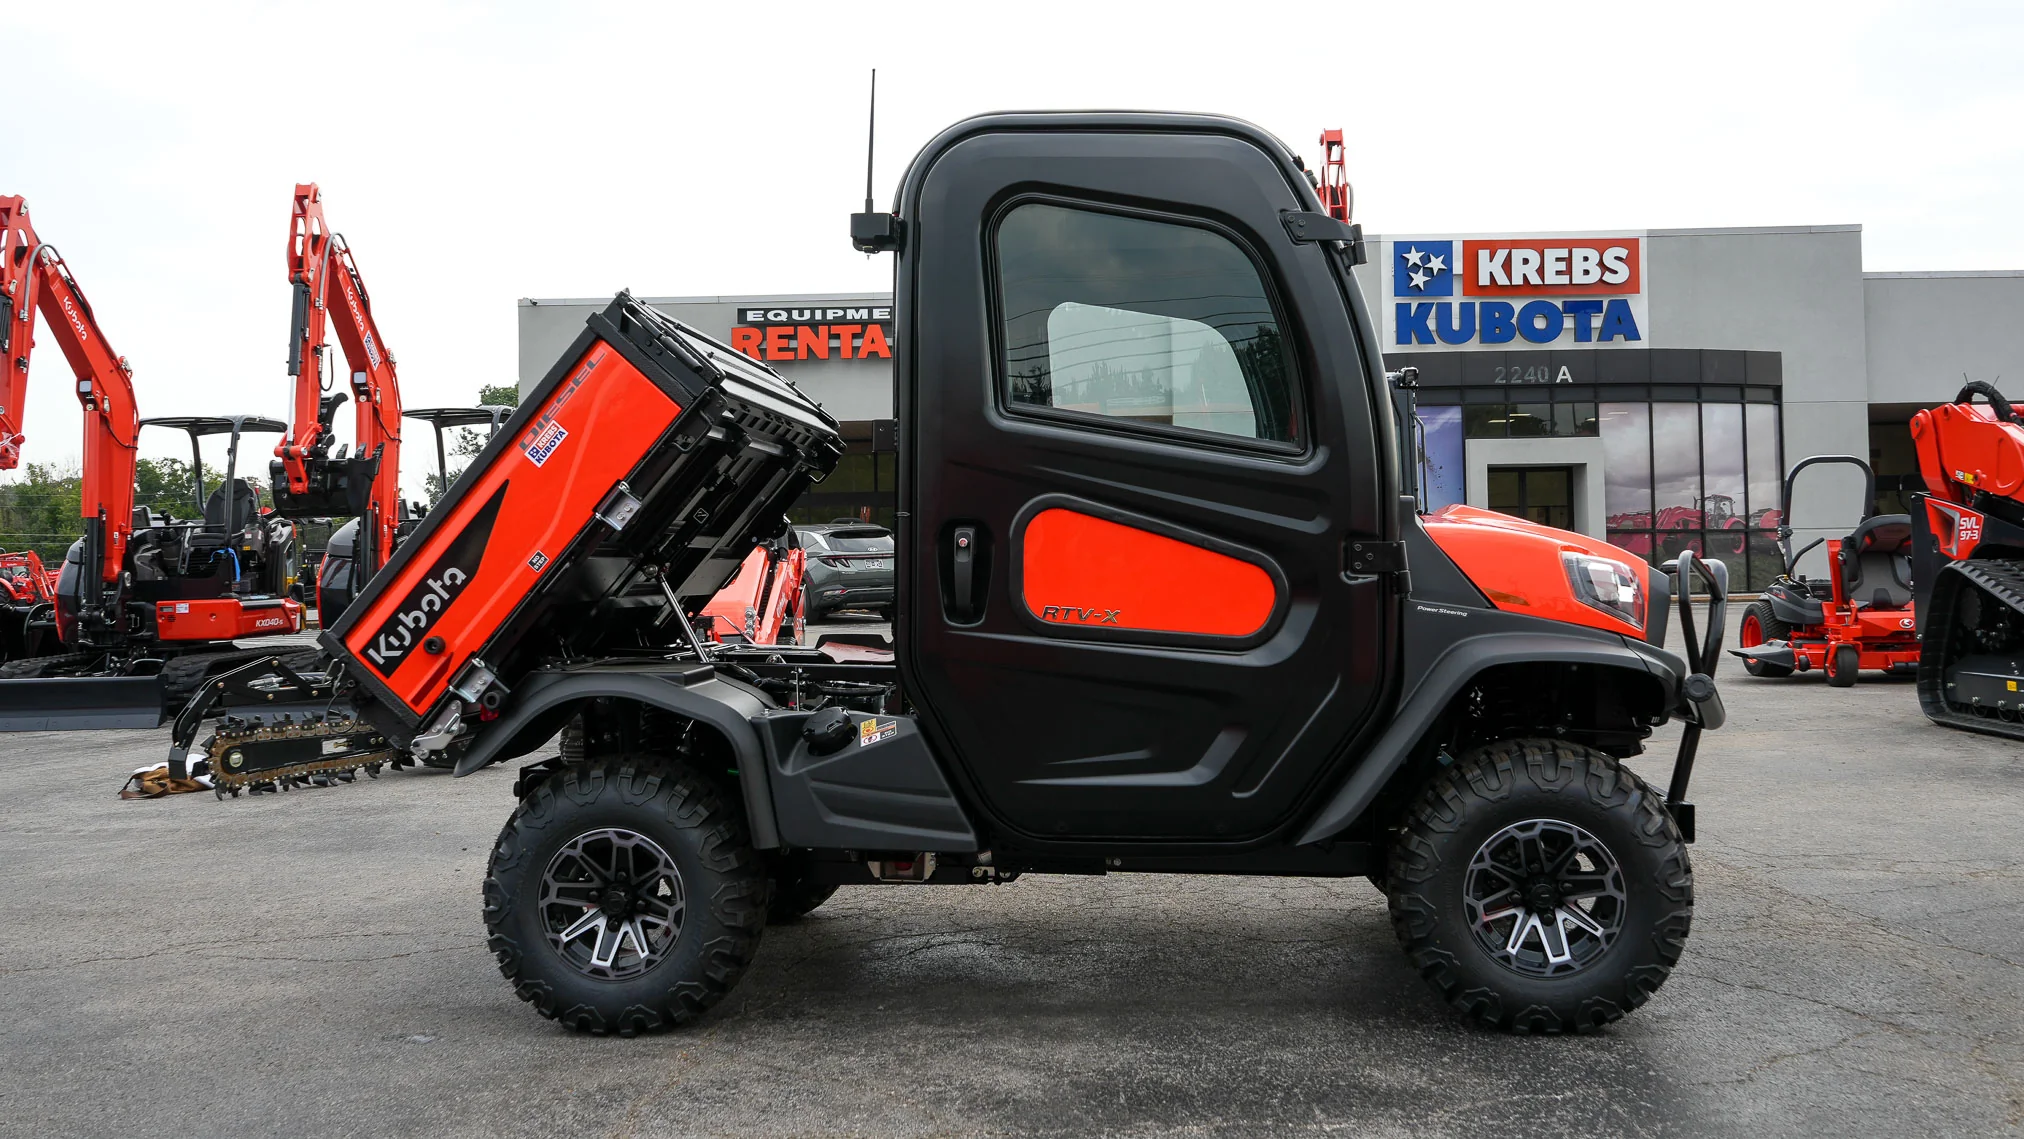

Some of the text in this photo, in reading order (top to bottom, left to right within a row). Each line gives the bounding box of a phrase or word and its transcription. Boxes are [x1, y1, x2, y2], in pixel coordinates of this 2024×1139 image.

[1478, 246, 1630, 287] KREBS
[63, 296, 88, 341] Kubota
[347, 286, 365, 331] Kubota
[1395, 299, 1641, 345] KUBOTA
[1494, 365, 1573, 384] 2240 A
[518, 352, 606, 451] DIESEL
[535, 430, 566, 464] KUBOTA
[538, 425, 557, 448] KREBS
[1959, 517, 1980, 530] SVL
[1960, 530, 1979, 541] 97-3
[532, 555, 540, 563] NO
[534, 557, 545, 570] STEP
[367, 567, 467, 665] Kubota
[1041, 605, 1121, 624] RTV-X
[1438, 609, 1468, 617] Steering
